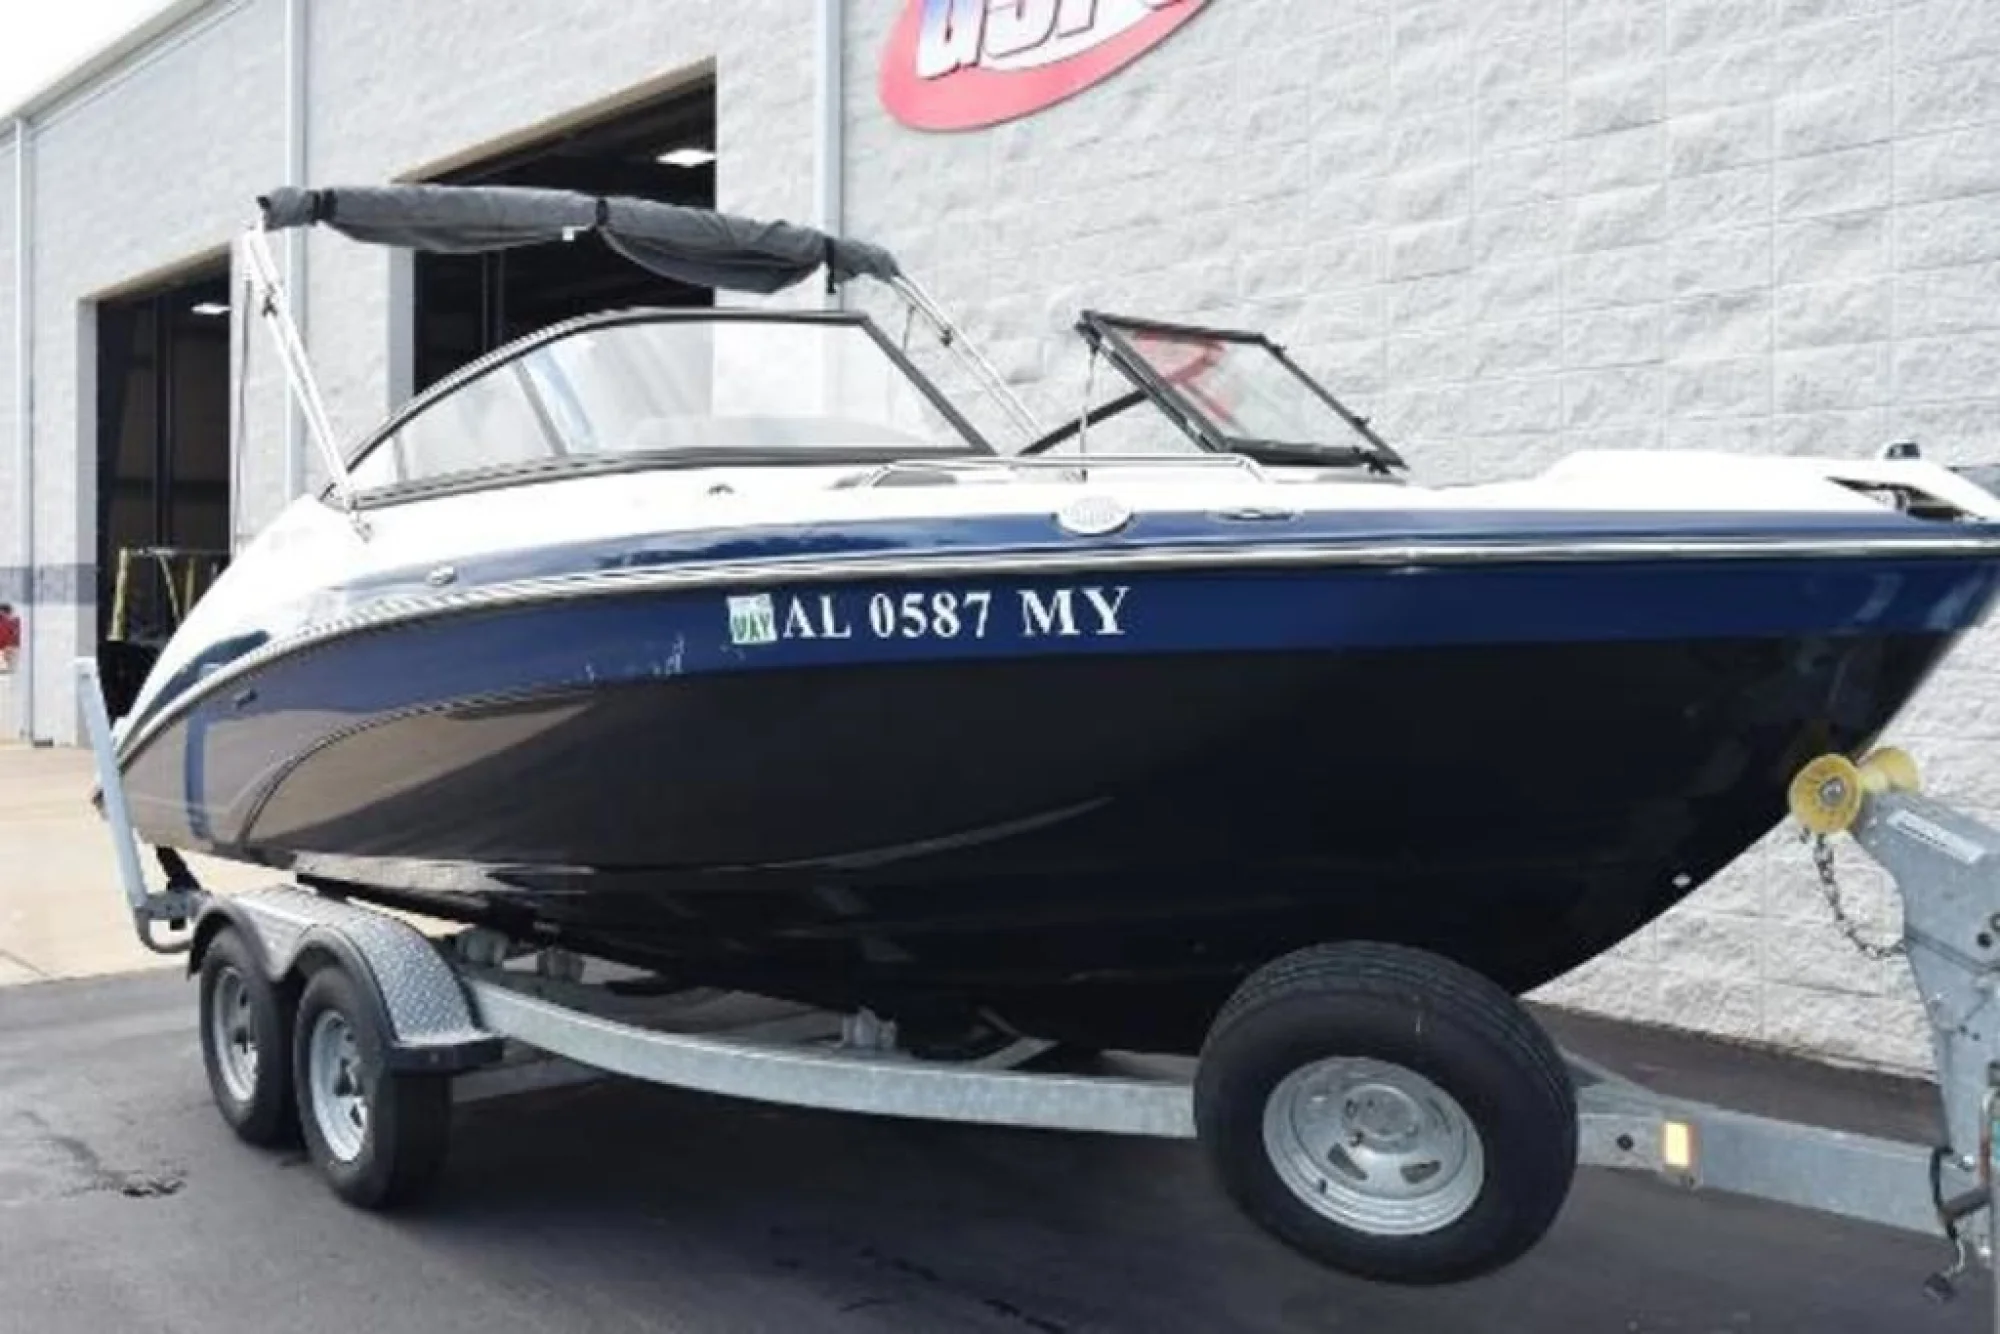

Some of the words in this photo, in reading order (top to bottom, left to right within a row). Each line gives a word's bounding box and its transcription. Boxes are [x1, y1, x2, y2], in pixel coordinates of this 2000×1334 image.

[782, 594, 851, 639] AL
[869, 592, 992, 639] 0587
[1017, 585, 1131, 637] MY
